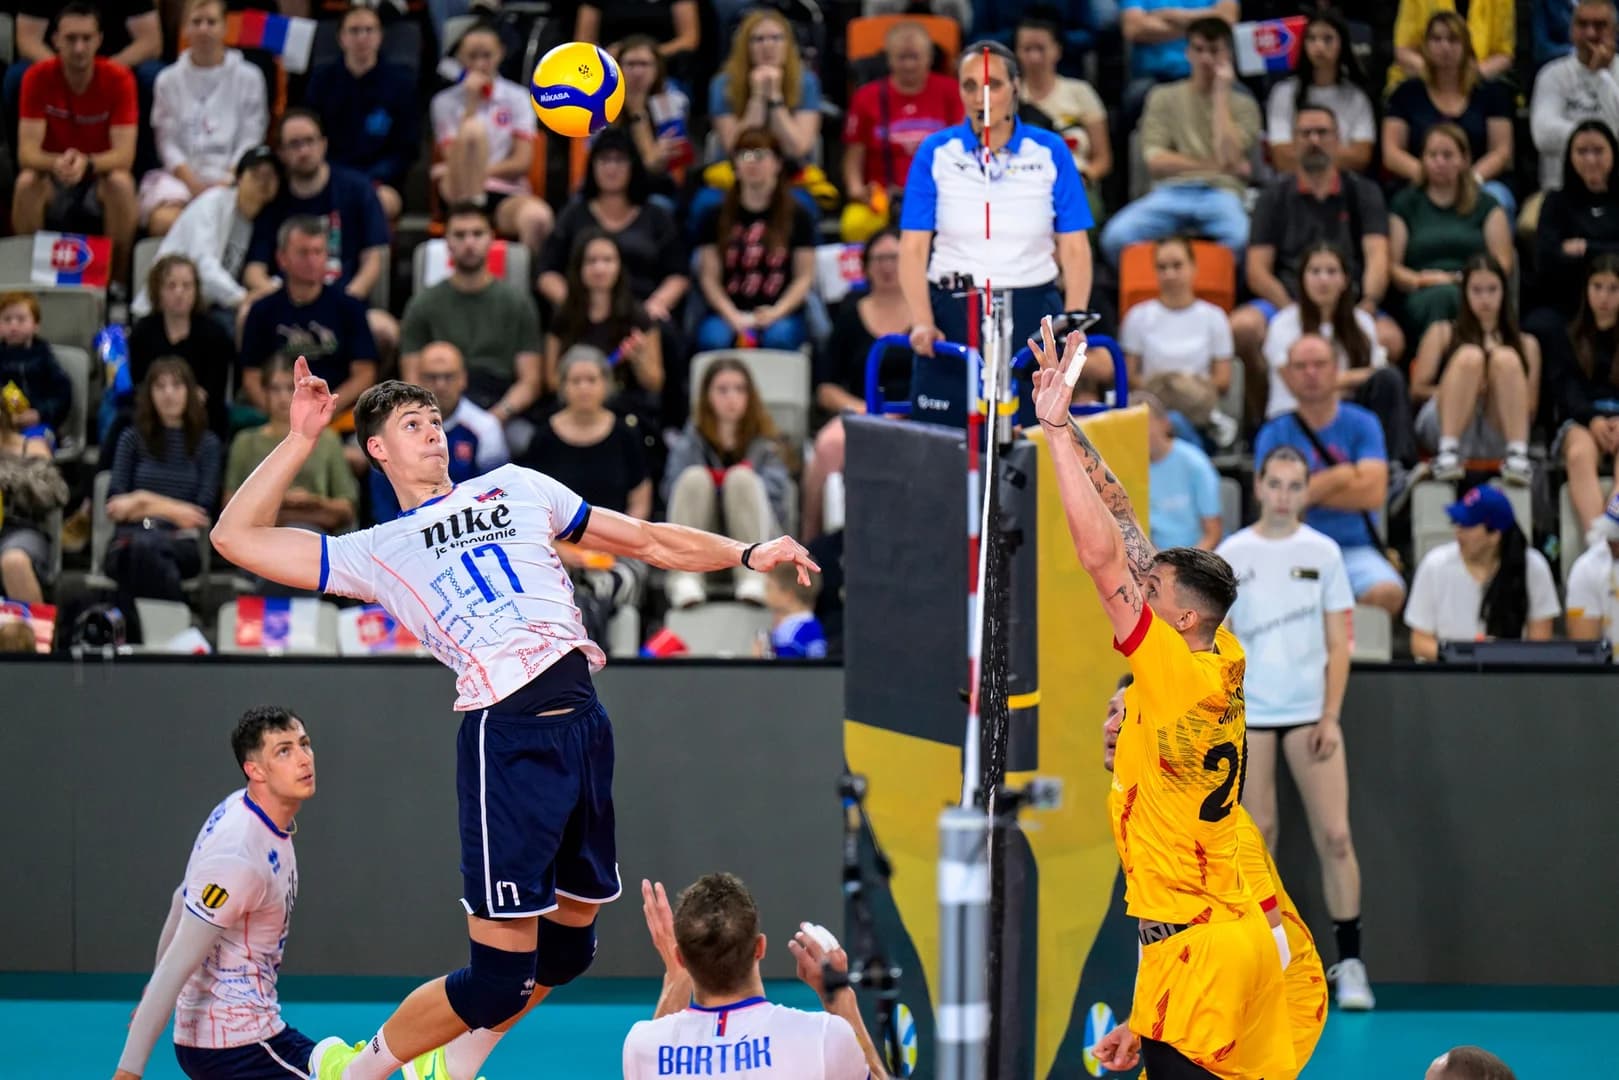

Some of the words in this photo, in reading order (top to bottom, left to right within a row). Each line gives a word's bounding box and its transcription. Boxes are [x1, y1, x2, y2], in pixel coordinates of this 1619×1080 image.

[460, 543, 525, 604] 17
[496, 879, 521, 906] 17
[658, 1034, 772, 1076] BARTÁK
